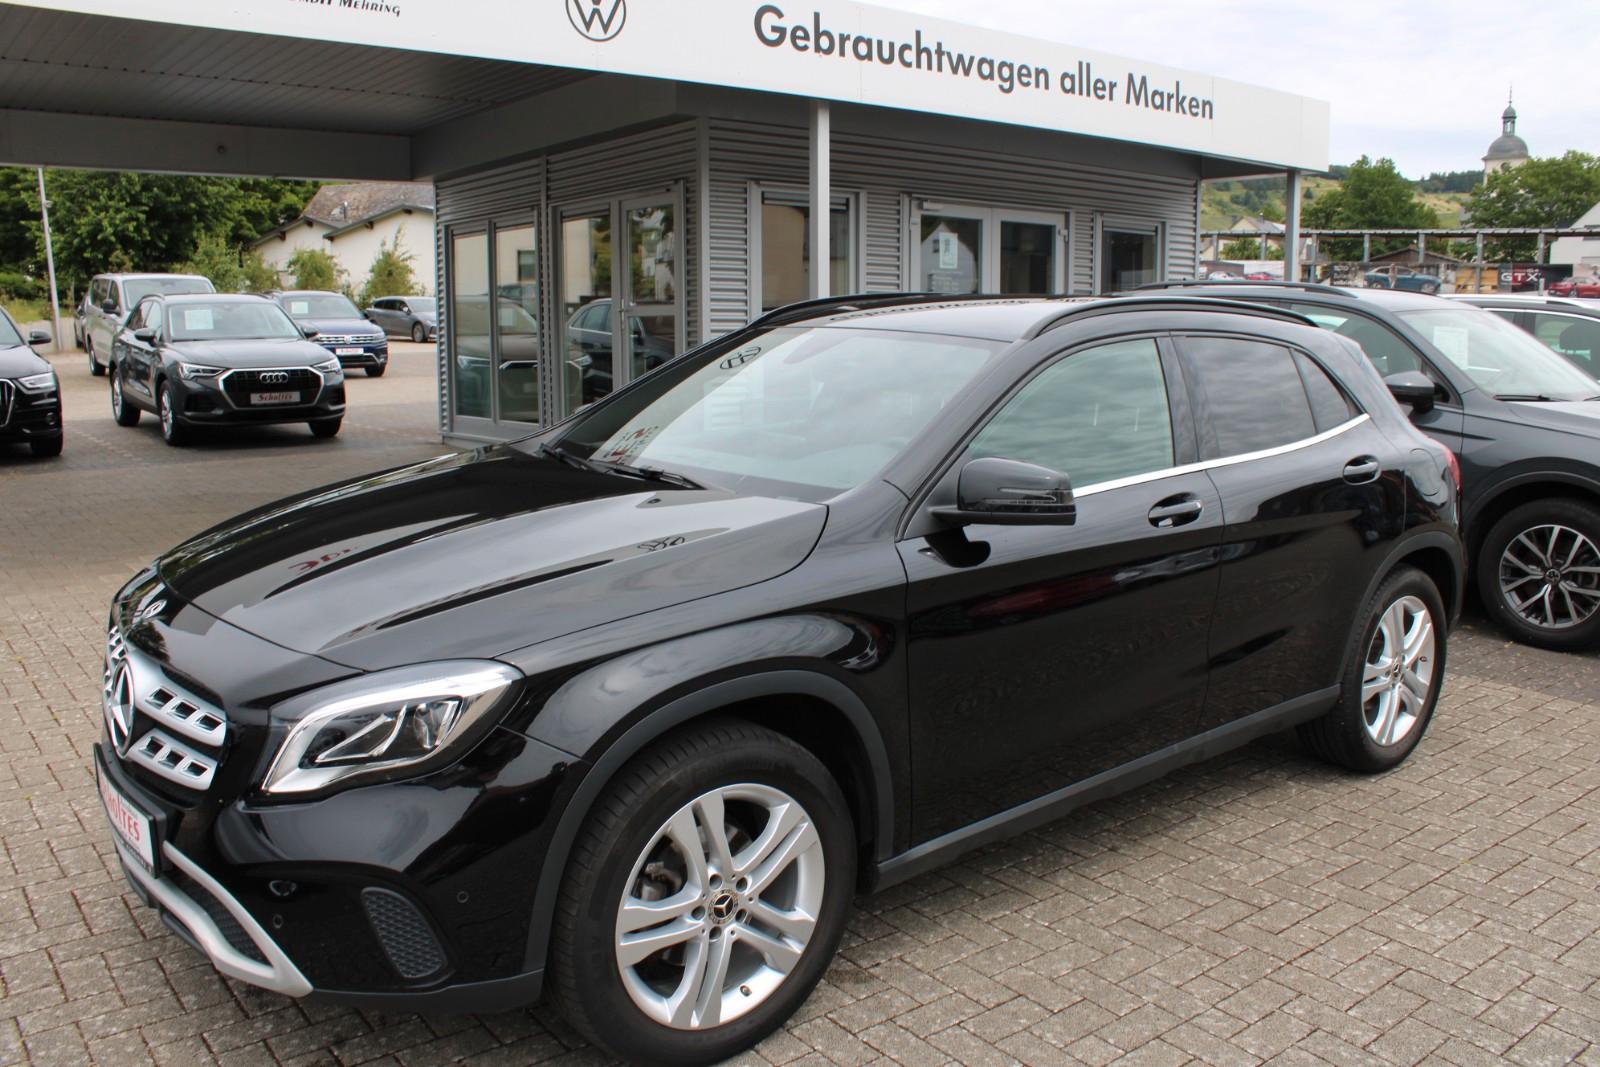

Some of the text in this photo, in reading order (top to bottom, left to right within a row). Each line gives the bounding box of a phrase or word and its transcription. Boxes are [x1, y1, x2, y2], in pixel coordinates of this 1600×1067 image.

[754, 4, 1214, 120] Gebrauchtwagen aller Marken
[1501, 272, 1538, 282] GTX
